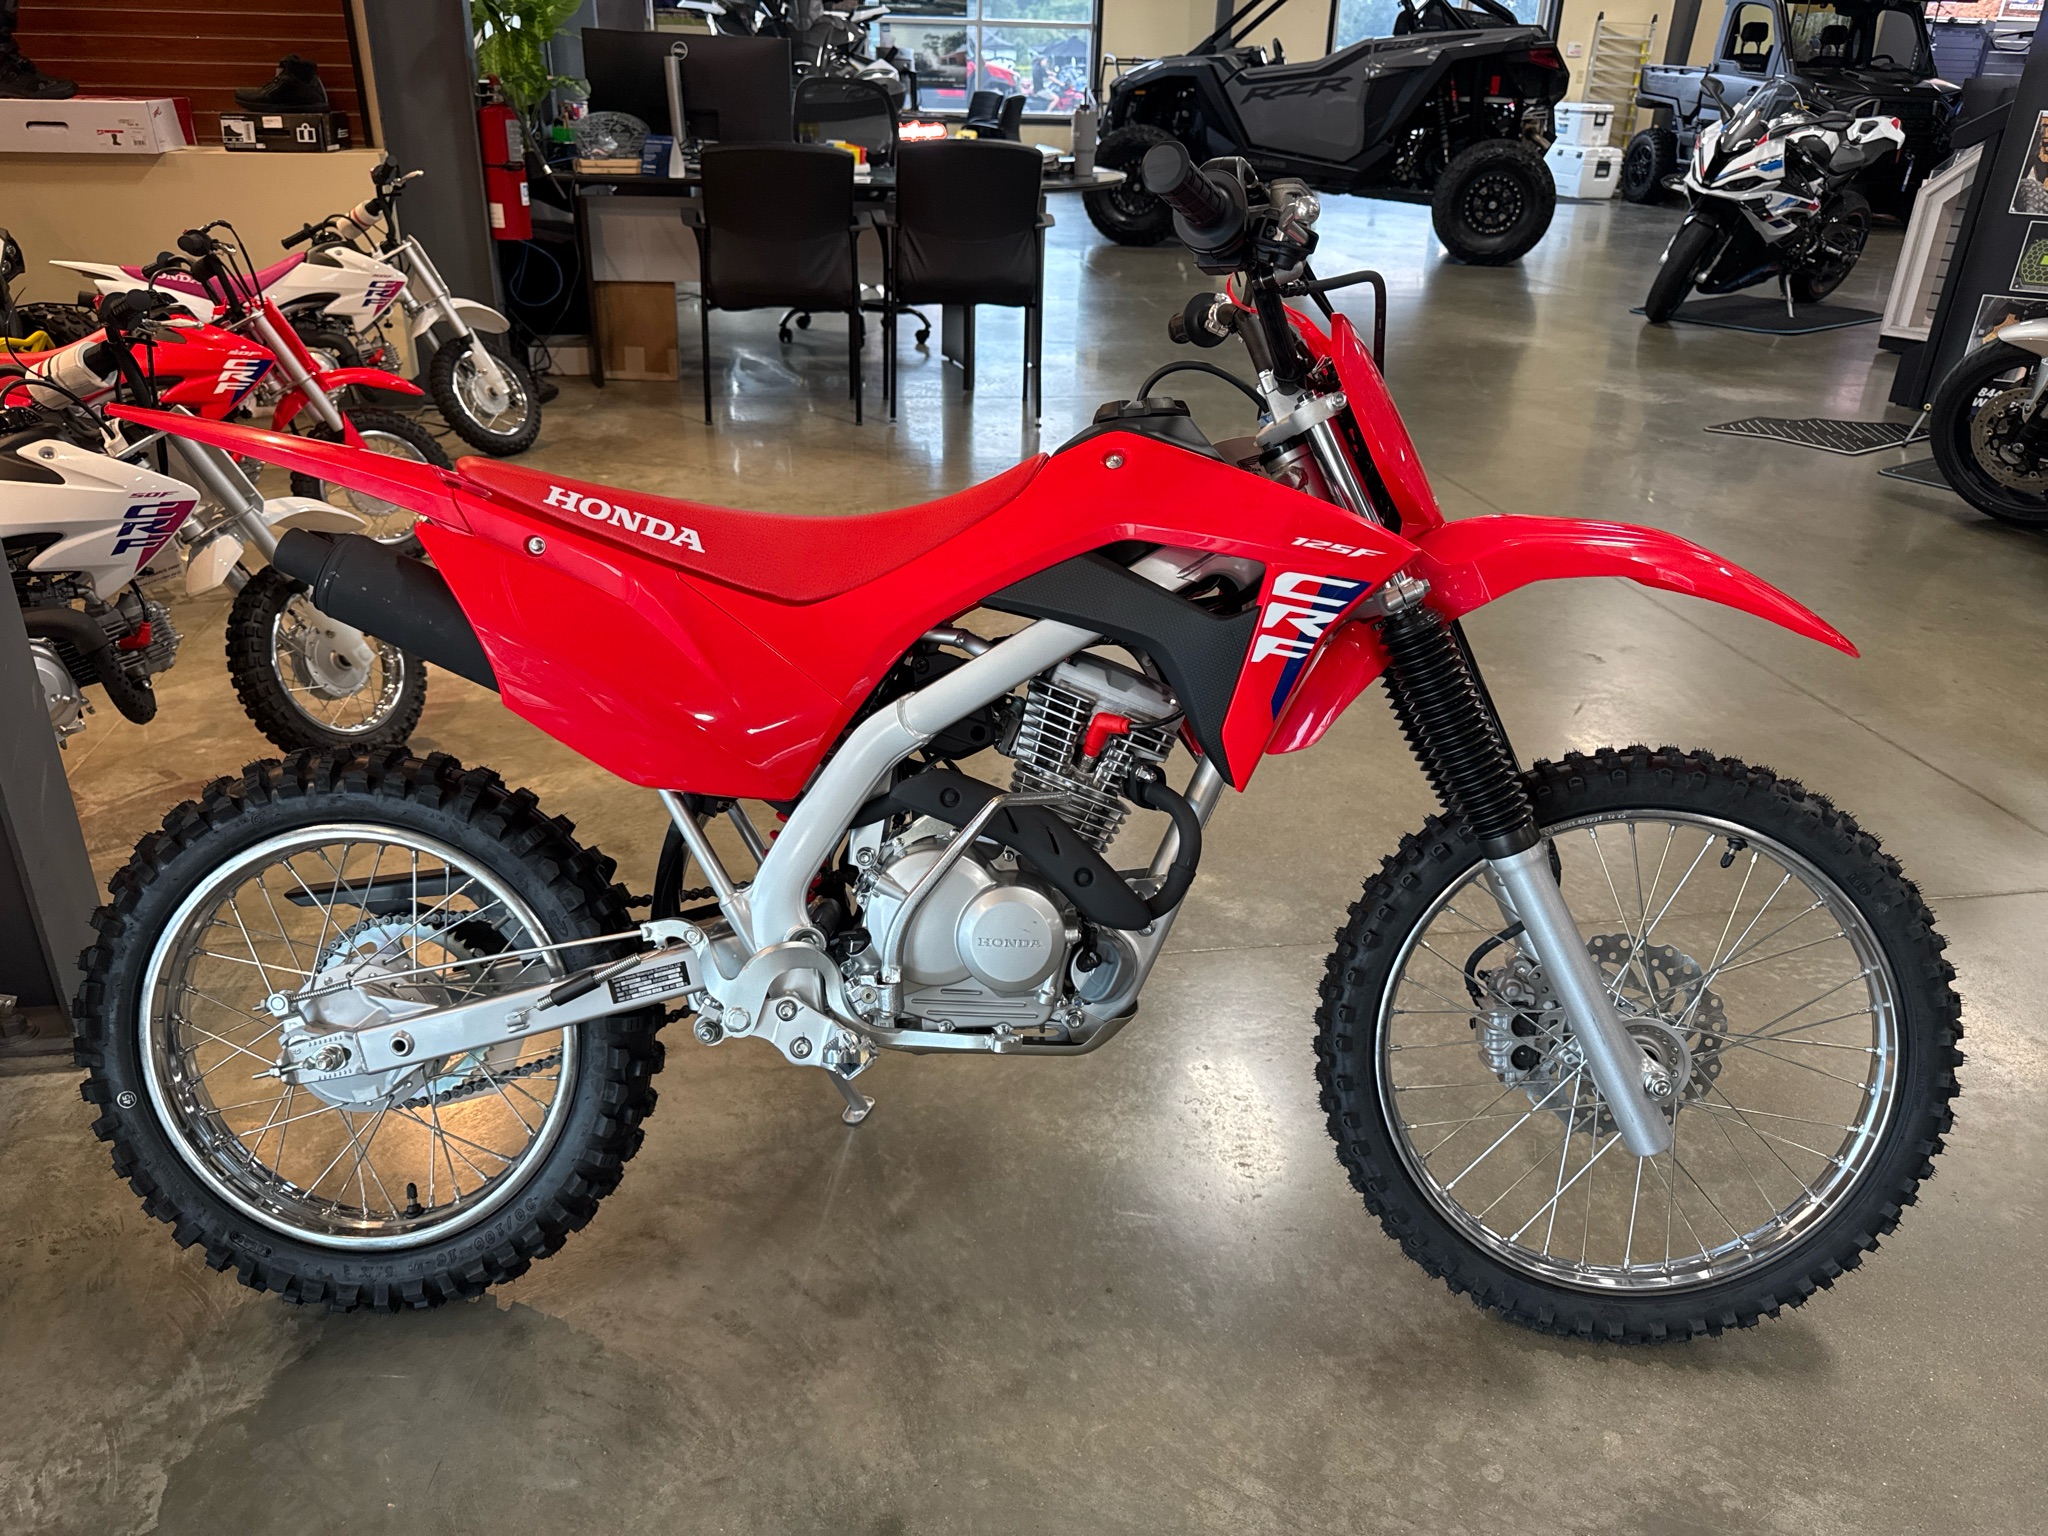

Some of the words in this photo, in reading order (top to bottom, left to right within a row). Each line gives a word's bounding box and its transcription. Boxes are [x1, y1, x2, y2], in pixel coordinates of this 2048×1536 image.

[1240, 76, 1353, 105] RZR
[157, 272, 203, 286] ONDA
[361, 280, 396, 307] CRF
[213, 358, 260, 394] CRF
[129, 490, 180, 499] 50F
[110, 501, 179, 556] CRF
[543, 485, 706, 554] HONDA
[1290, 536, 1388, 558] 125F
[1250, 571, 1360, 663] CRF
[977, 937, 1046, 949] HONDA
